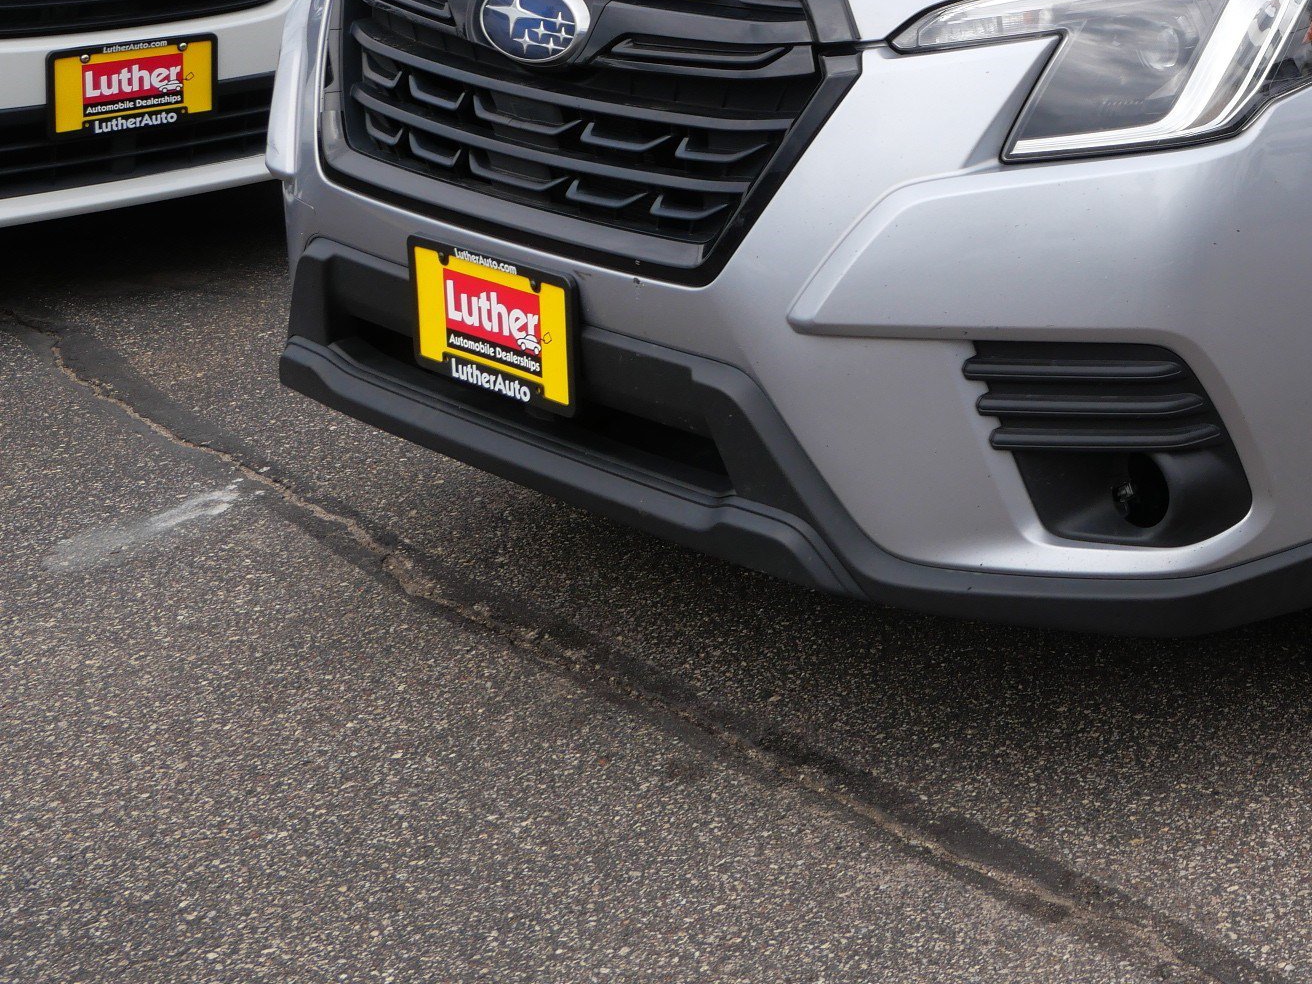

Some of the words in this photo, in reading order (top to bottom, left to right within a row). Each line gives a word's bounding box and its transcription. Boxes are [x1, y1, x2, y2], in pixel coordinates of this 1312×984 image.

[102, 40, 168, 54] LutherAuto.com
[85, 64, 181, 98] Luther
[86, 100, 135, 114] Automobile
[136, 94, 182, 108] Dealerships
[94, 111, 178, 134] LutherAuto
[454, 247, 517, 275] LutherAuto.com
[446, 279, 539, 339] Luther
[449, 333, 495, 357] Automobile
[495, 347, 541, 372] Dealerships
[451, 357, 531, 403] LutherAuto
